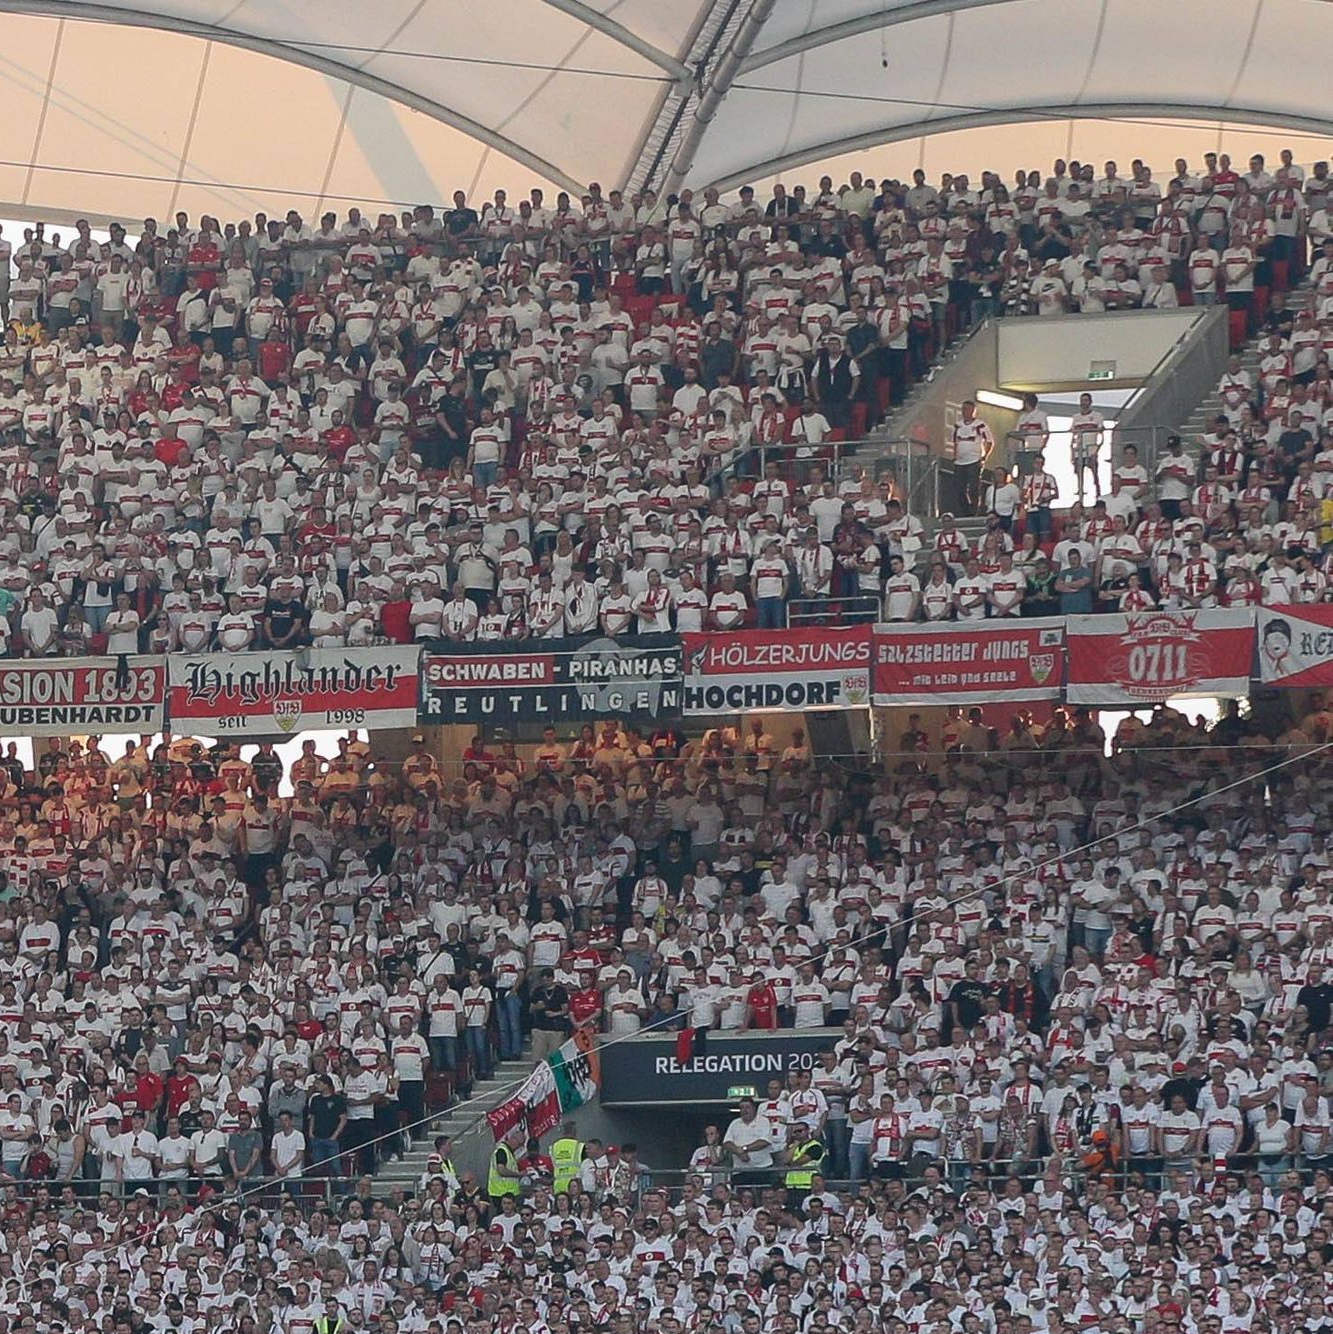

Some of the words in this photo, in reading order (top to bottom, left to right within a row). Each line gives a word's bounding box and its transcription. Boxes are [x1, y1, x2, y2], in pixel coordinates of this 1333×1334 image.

[710, 642, 870, 667] HÖLZERJUNGS
[1129, 645, 1187, 681] 0711
[429, 662, 545, 681] SCHWABEN
[569, 657, 677, 677] PIRANHAS
[83, 669, 157, 701] 1893
[184, 658, 402, 706] Highlander
[427, 690, 677, 714] REUTLINGEN
[685, 681, 841, 710] HOCHDORF
[218, 714, 247, 728] seit
[325, 709, 366, 725] 1998
[655, 1054, 782, 1073] RELEGATION
